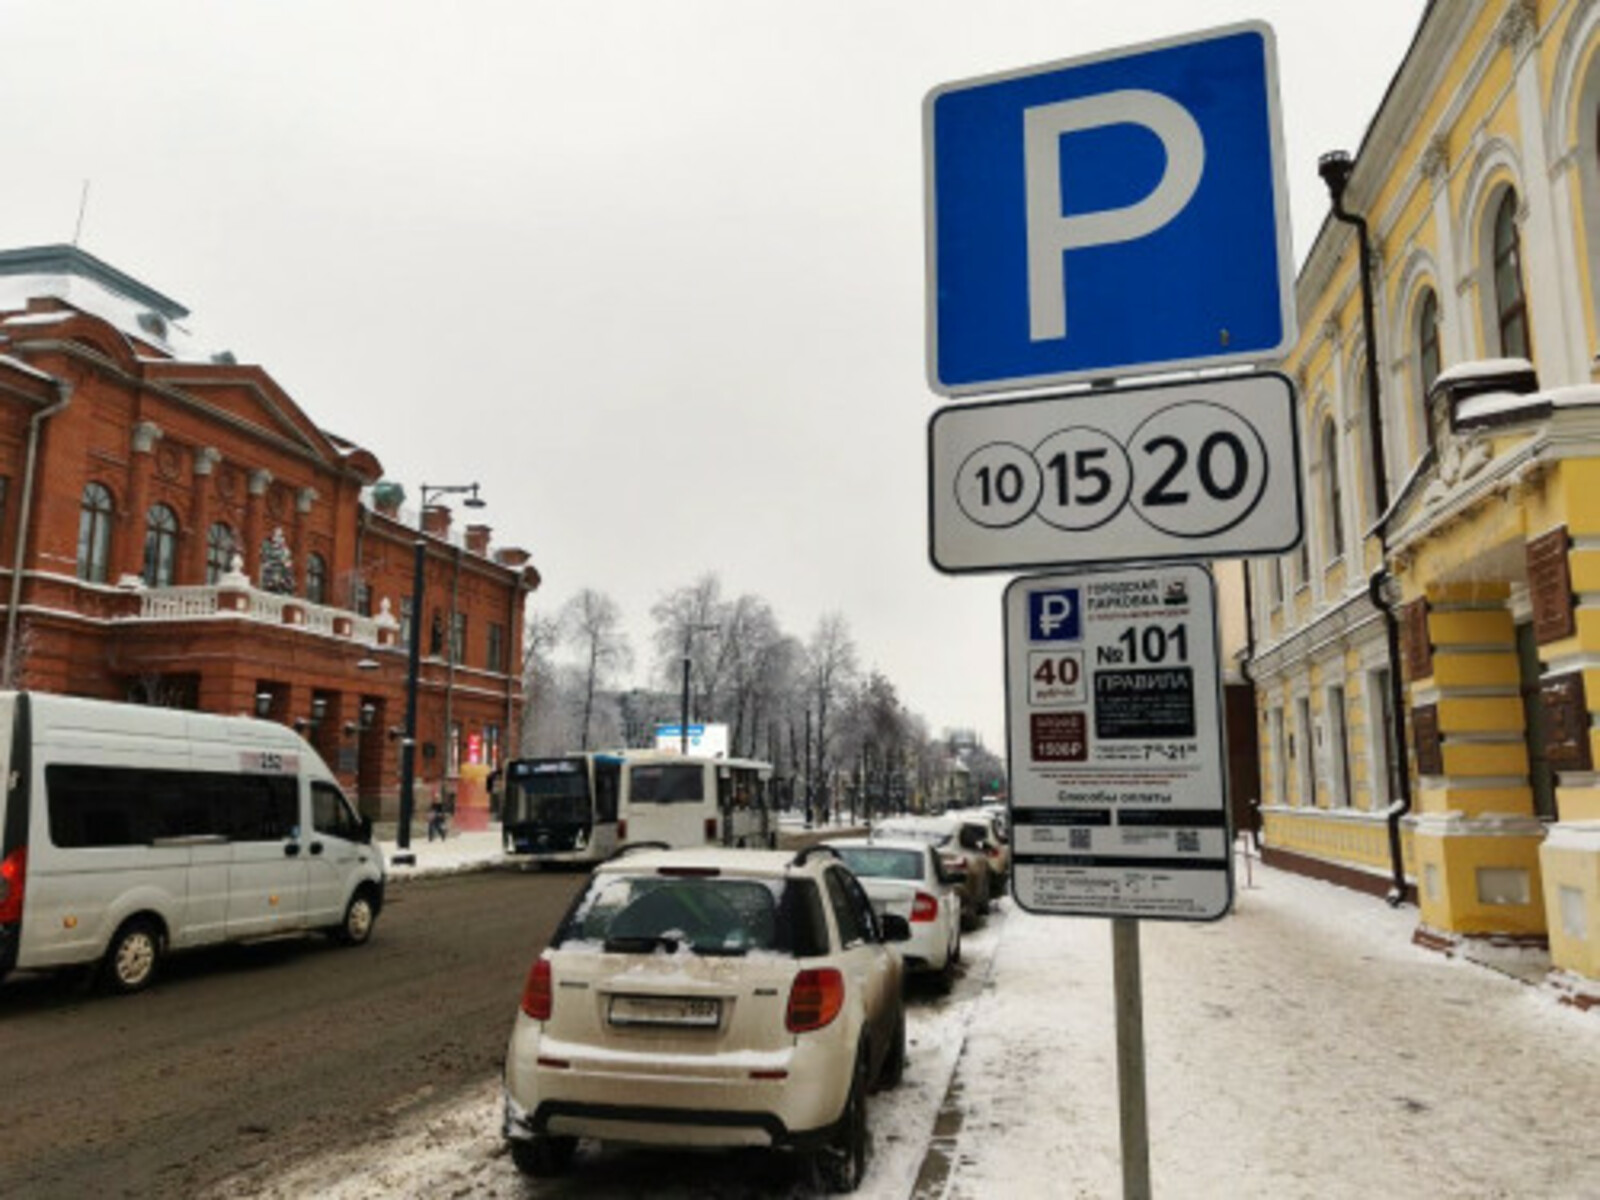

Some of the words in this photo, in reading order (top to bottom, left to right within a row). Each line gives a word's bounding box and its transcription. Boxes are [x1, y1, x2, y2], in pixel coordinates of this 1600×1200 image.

[1023, 89, 1205, 342] P
[975, 463, 1024, 506] 10
[1047, 448, 1112, 507] 15
[1142, 431, 1249, 507] 20
[1033, 657, 1079, 686] 40
[1097, 673, 1188, 691] ПРАВИЛА
